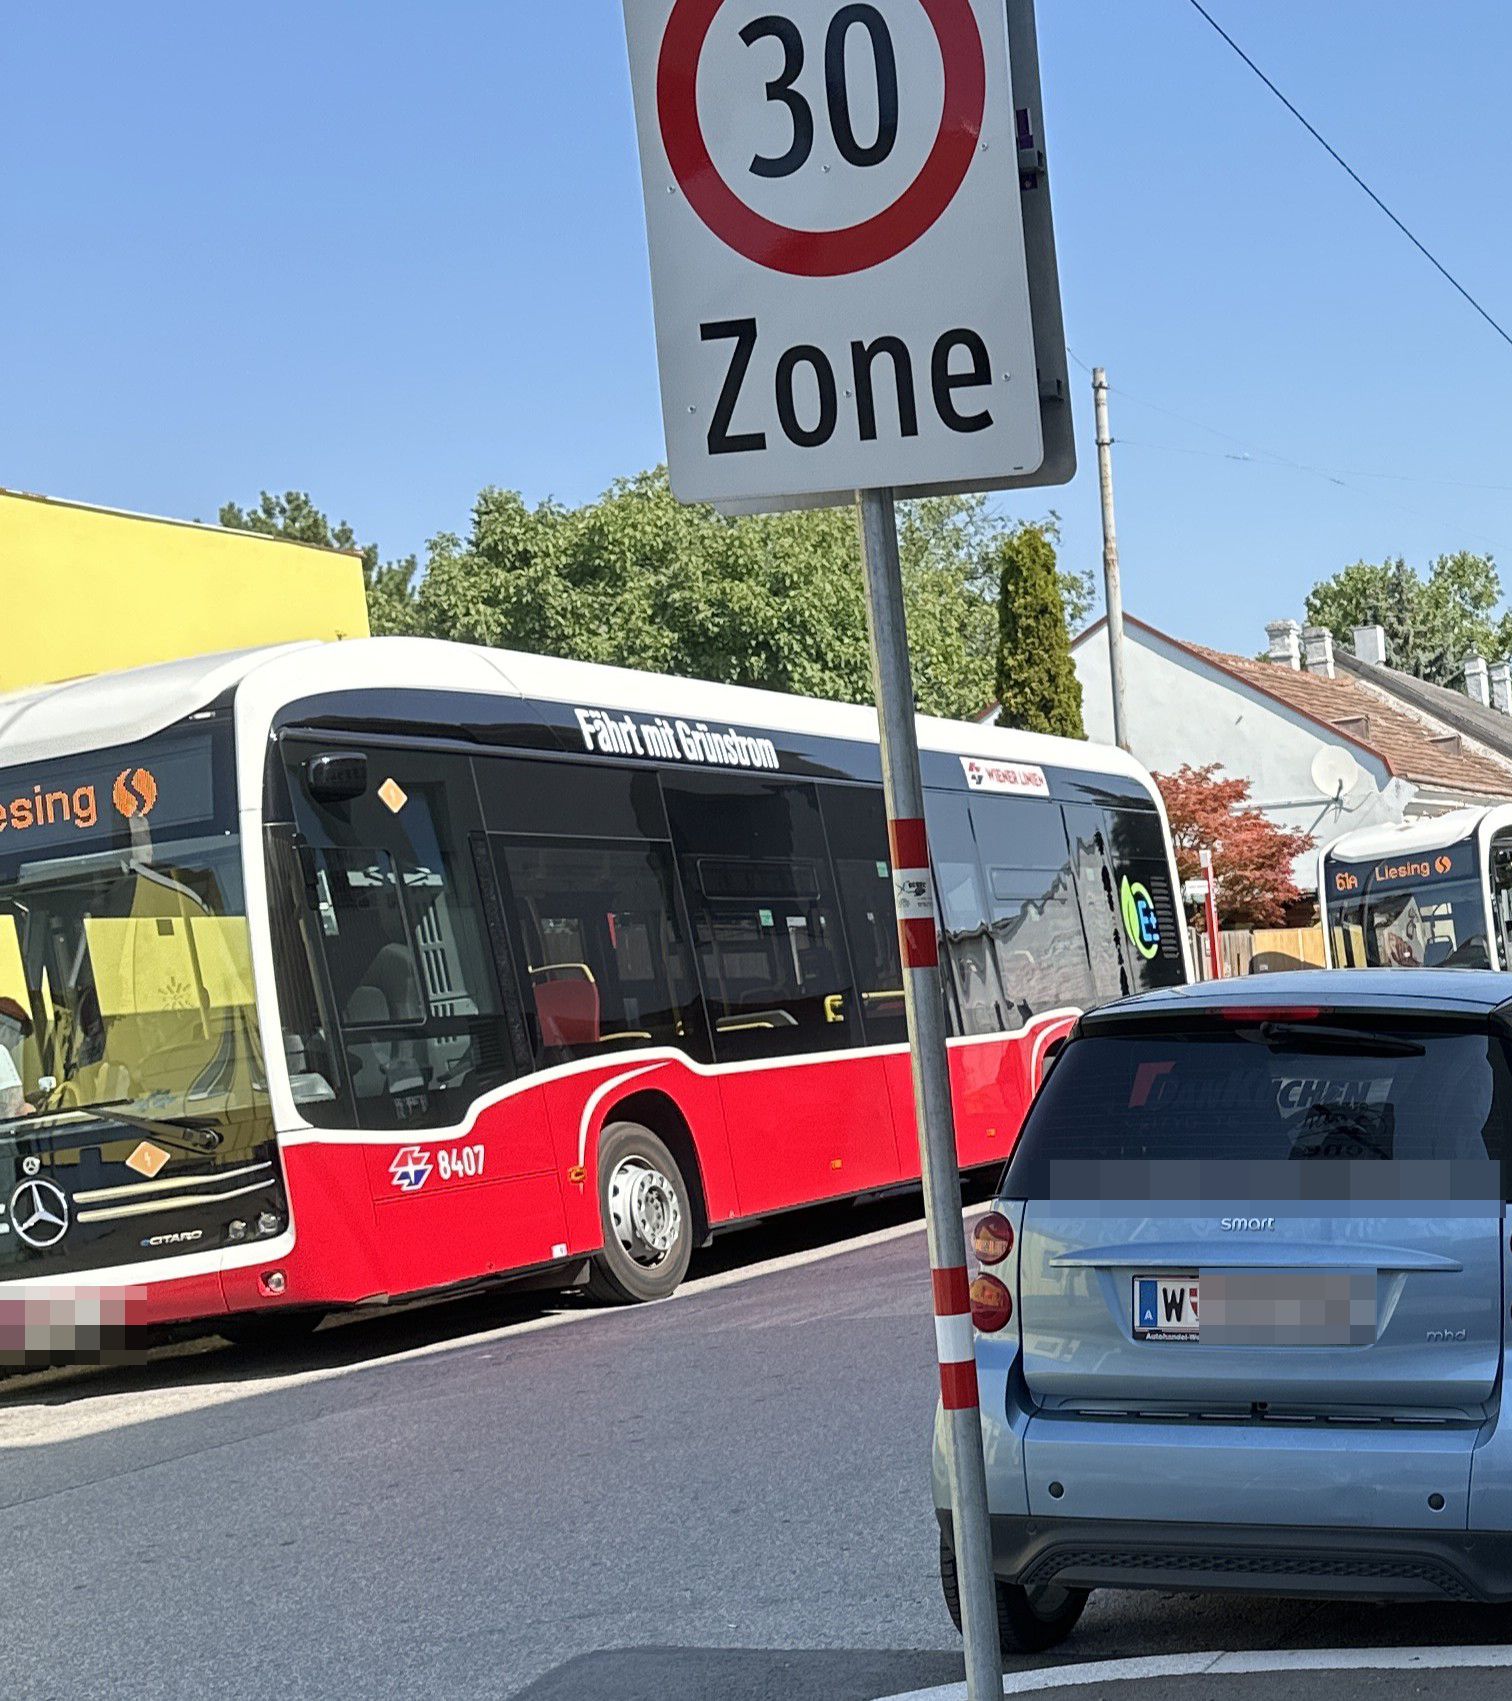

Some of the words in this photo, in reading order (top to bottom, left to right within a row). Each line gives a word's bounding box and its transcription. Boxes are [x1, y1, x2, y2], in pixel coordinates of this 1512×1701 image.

[738, 3, 899, 178] 30
[700, 317, 994, 455] Zone
[574, 708, 644, 755] Fährt
[640, 717, 682, 759] mit
[674, 720, 780, 769] Grünstrom
[1375, 861, 1431, 881] Liesing
[437, 1144, 485, 1180] 8407
[1220, 1217, 1275, 1232] smart
[1143, 1309, 1154, 1320] A
[1162, 1286, 1185, 1323] W
[1426, 1328, 1466, 1342] mhd
